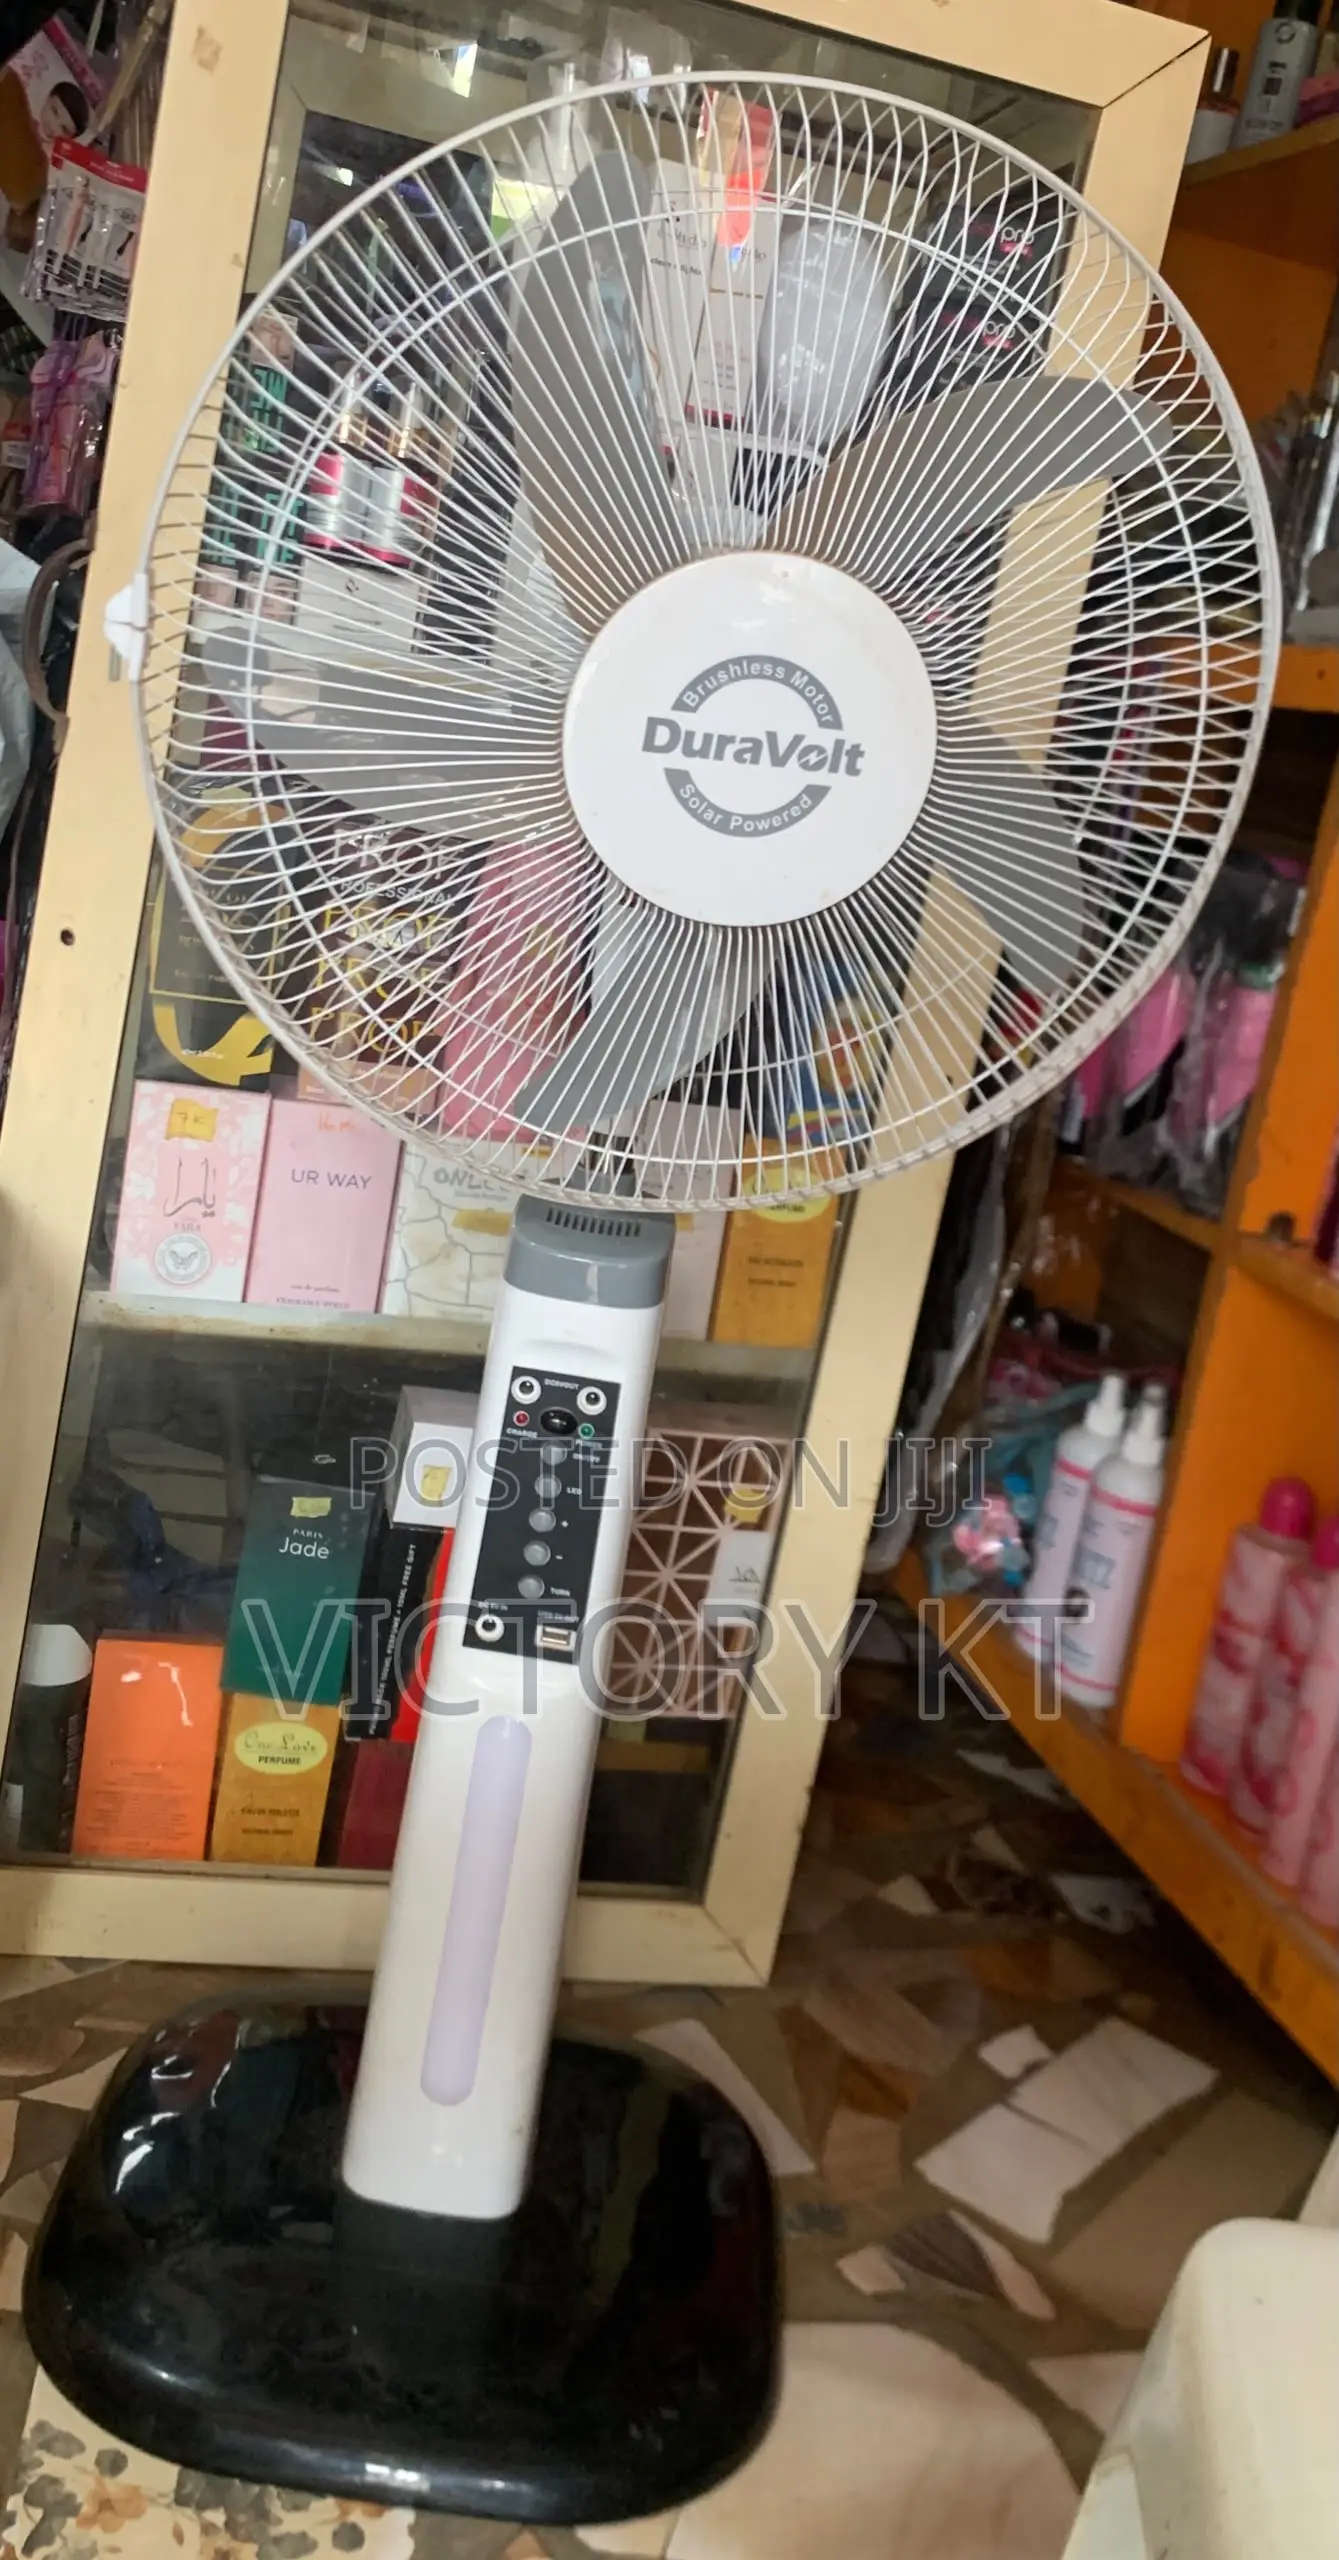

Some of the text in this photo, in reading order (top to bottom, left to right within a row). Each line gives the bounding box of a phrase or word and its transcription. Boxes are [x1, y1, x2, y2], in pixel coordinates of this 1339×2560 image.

[683, 660, 833, 723] Brushless Motor
[642, 716, 865, 777] DuraVolt
[680, 783, 812, 832] Solar Powered
[291, 1168, 372, 1189] UR WAY
[566, 1486, 582, 1496] LED
[293, 1528, 324, 1540] PARIS
[278, 1536, 330, 1560] Jade
[407, 1543, 417, 1564] GIFT
[402, 1563, 413, 1587] FREE
[550, 1586, 571, 1597] TURN
[258, 1754, 302, 1767] PERFUME
